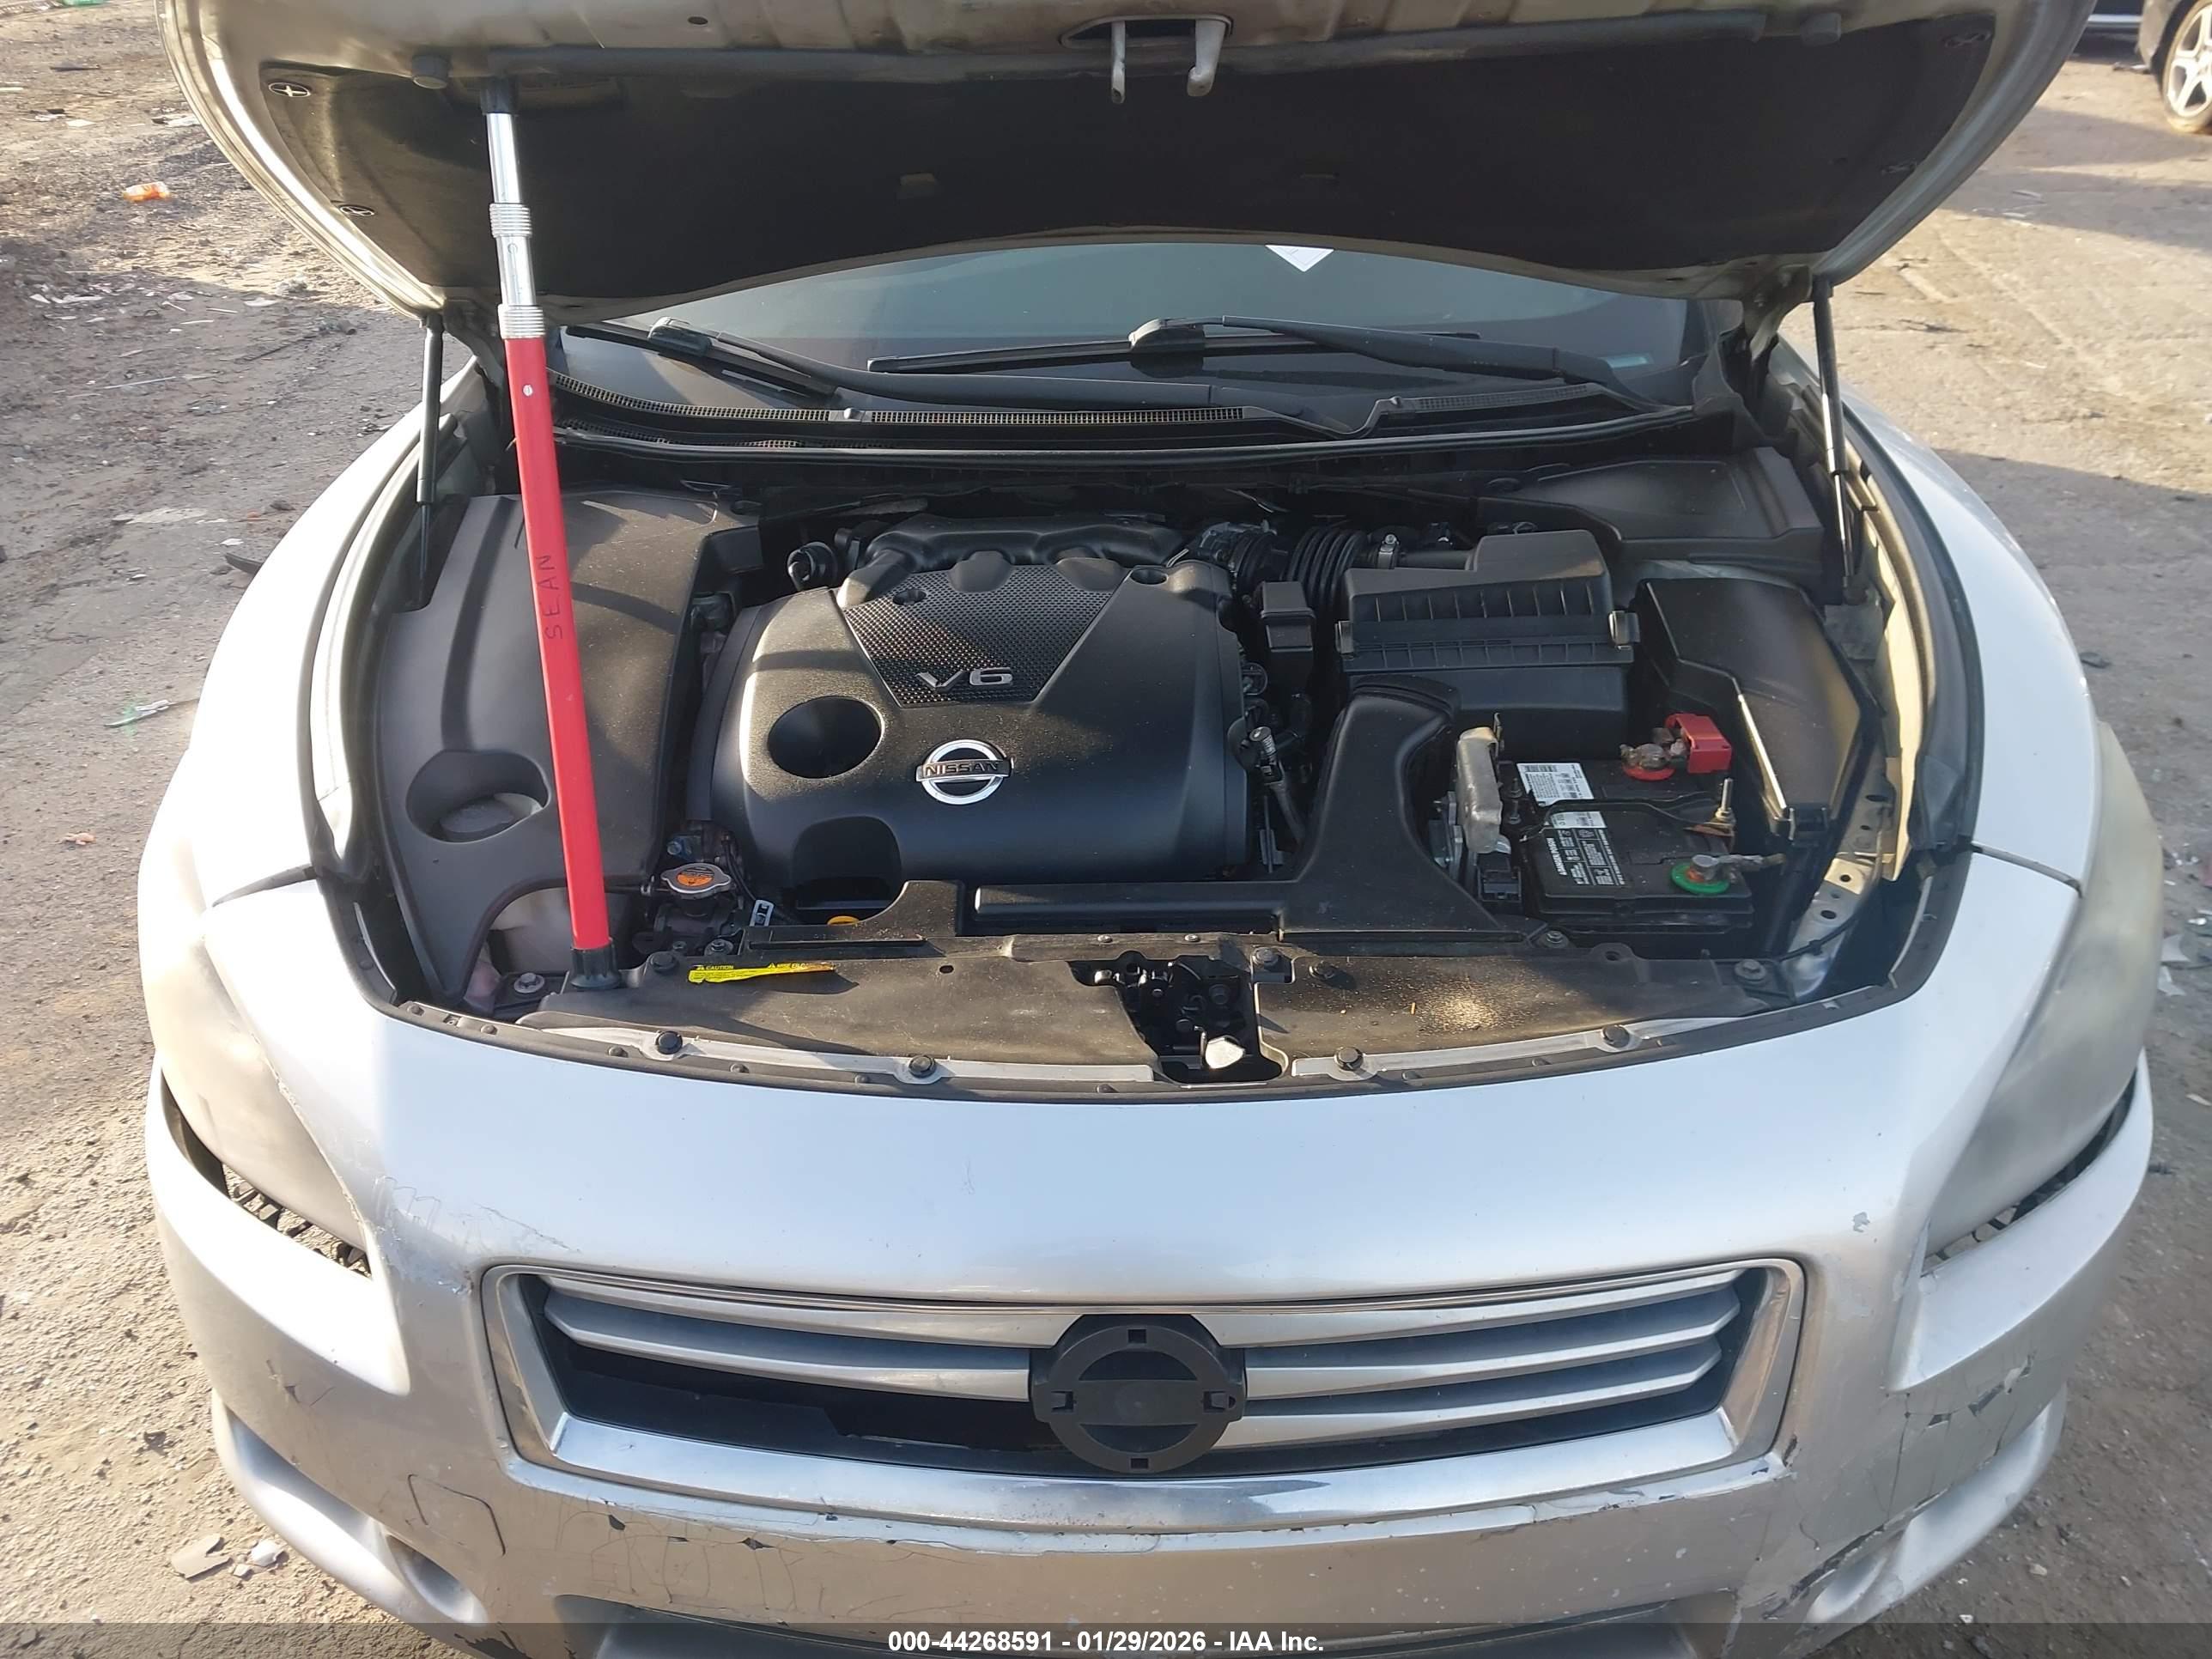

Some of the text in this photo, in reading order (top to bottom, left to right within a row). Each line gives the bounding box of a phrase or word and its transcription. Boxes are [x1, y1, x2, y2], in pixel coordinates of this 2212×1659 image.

[536, 554, 563, 641] SEAN
[915, 666, 1013, 690] V6
[925, 762, 1000, 777] NISSAN
